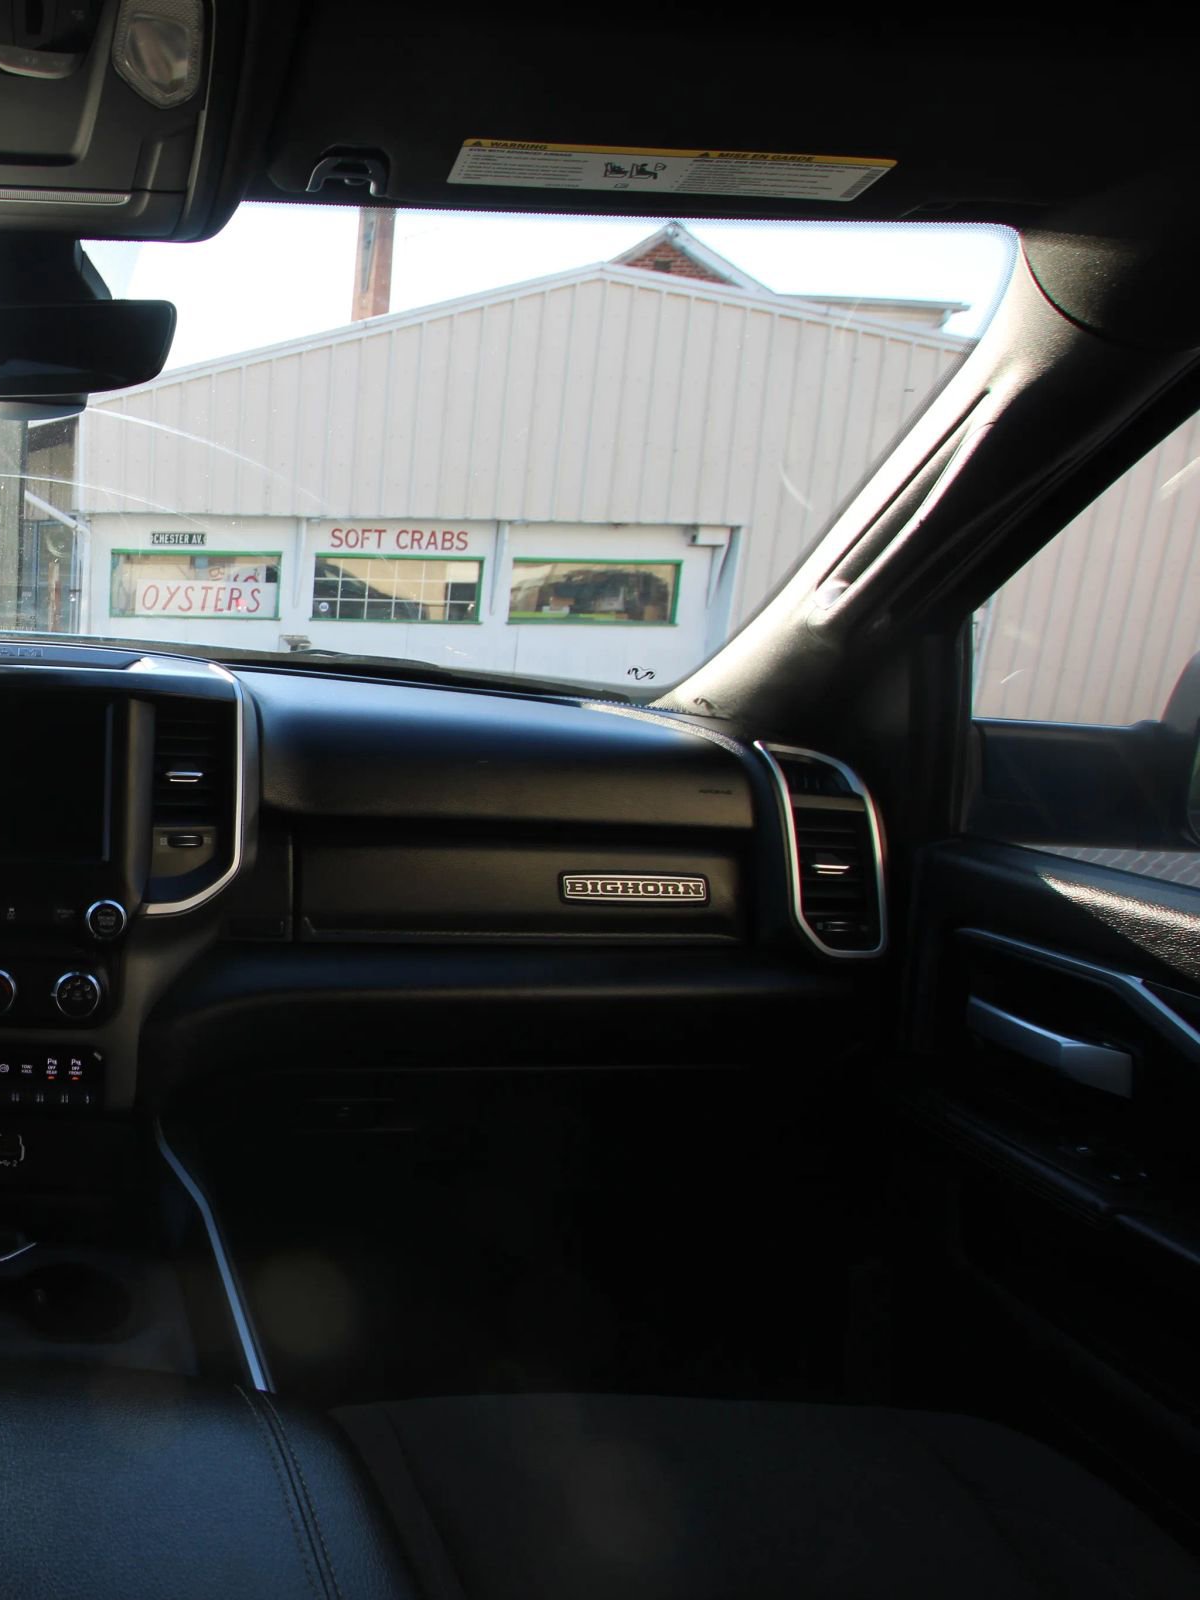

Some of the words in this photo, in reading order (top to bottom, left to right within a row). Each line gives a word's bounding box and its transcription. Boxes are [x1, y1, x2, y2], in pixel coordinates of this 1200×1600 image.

[490, 141, 548, 150] WARNING
[770, 154, 816, 162] GARDE
[154, 533, 189, 545] CHESTER
[330, 528, 387, 549] SOFT
[395, 529, 469, 551] CRABS
[141, 584, 261, 613] OYSTERS
[566, 879, 704, 897] BIGHORN
